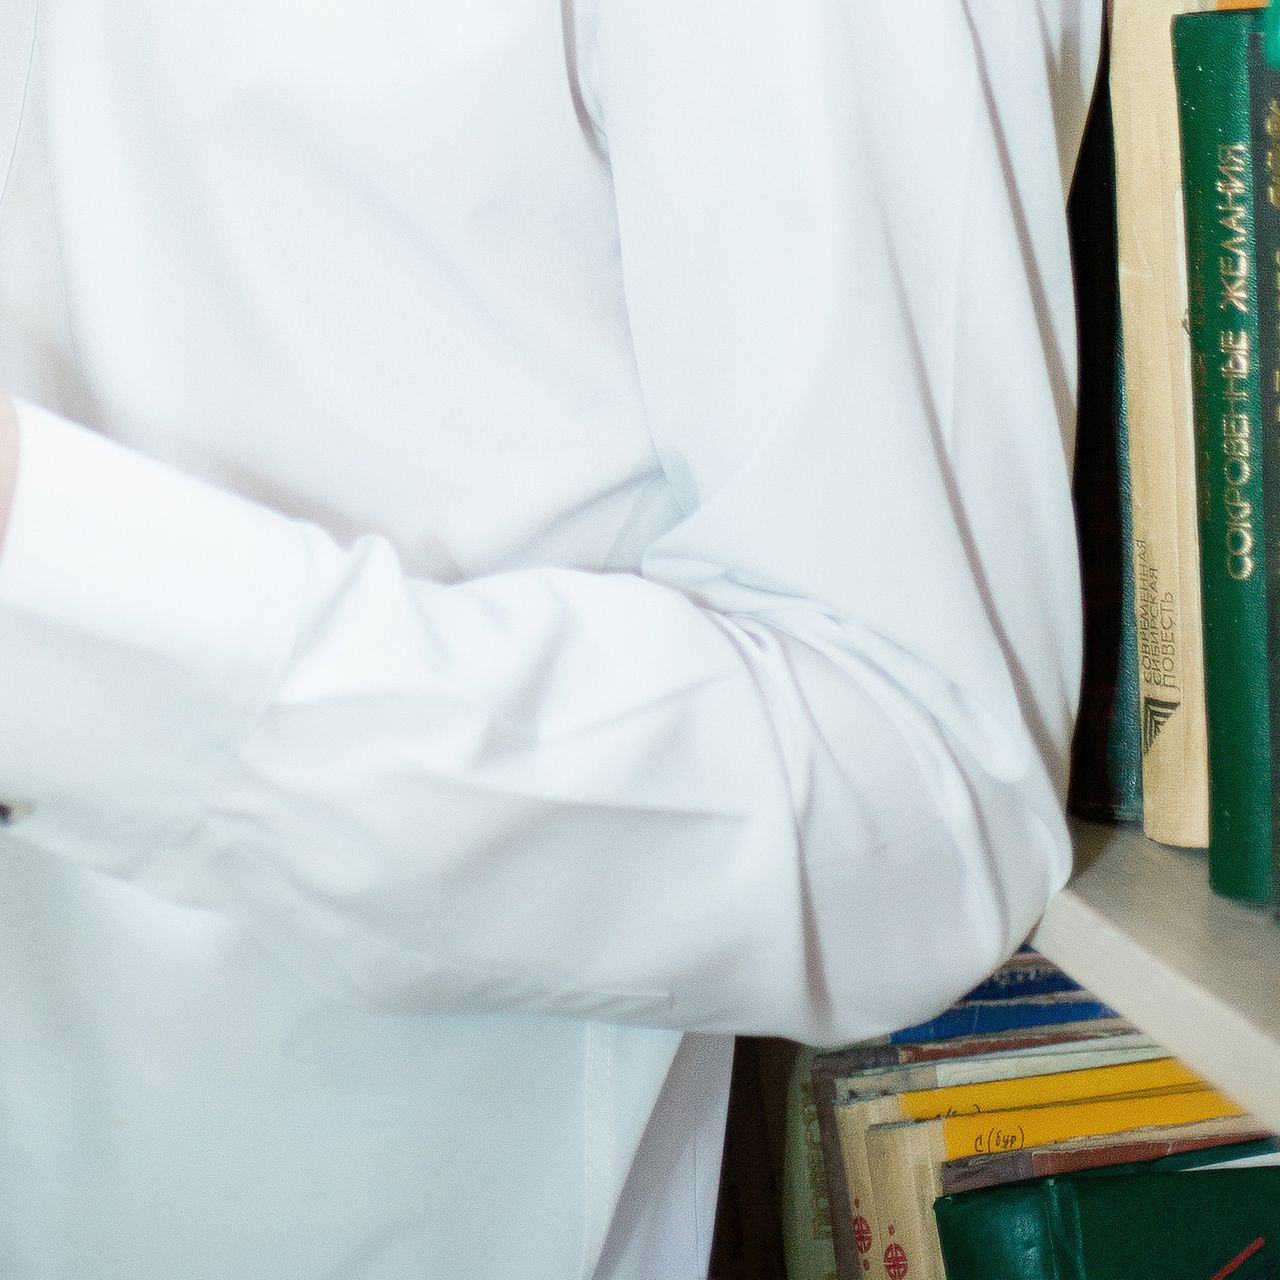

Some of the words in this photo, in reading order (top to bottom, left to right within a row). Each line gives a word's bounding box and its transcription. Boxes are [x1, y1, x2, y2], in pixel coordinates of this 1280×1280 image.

[1215, 141, 1250, 313] ЖЕЛАНИЯ
[1220, 329, 1255, 581] СОКРОВЕННЫЕ
[1135, 539, 1152, 685] СОВРЕМЕННАЯ
[1148, 567, 1162, 686] СИБИРСКАЯ
[1160, 591, 1180, 692] ПОВЕСТЬ
